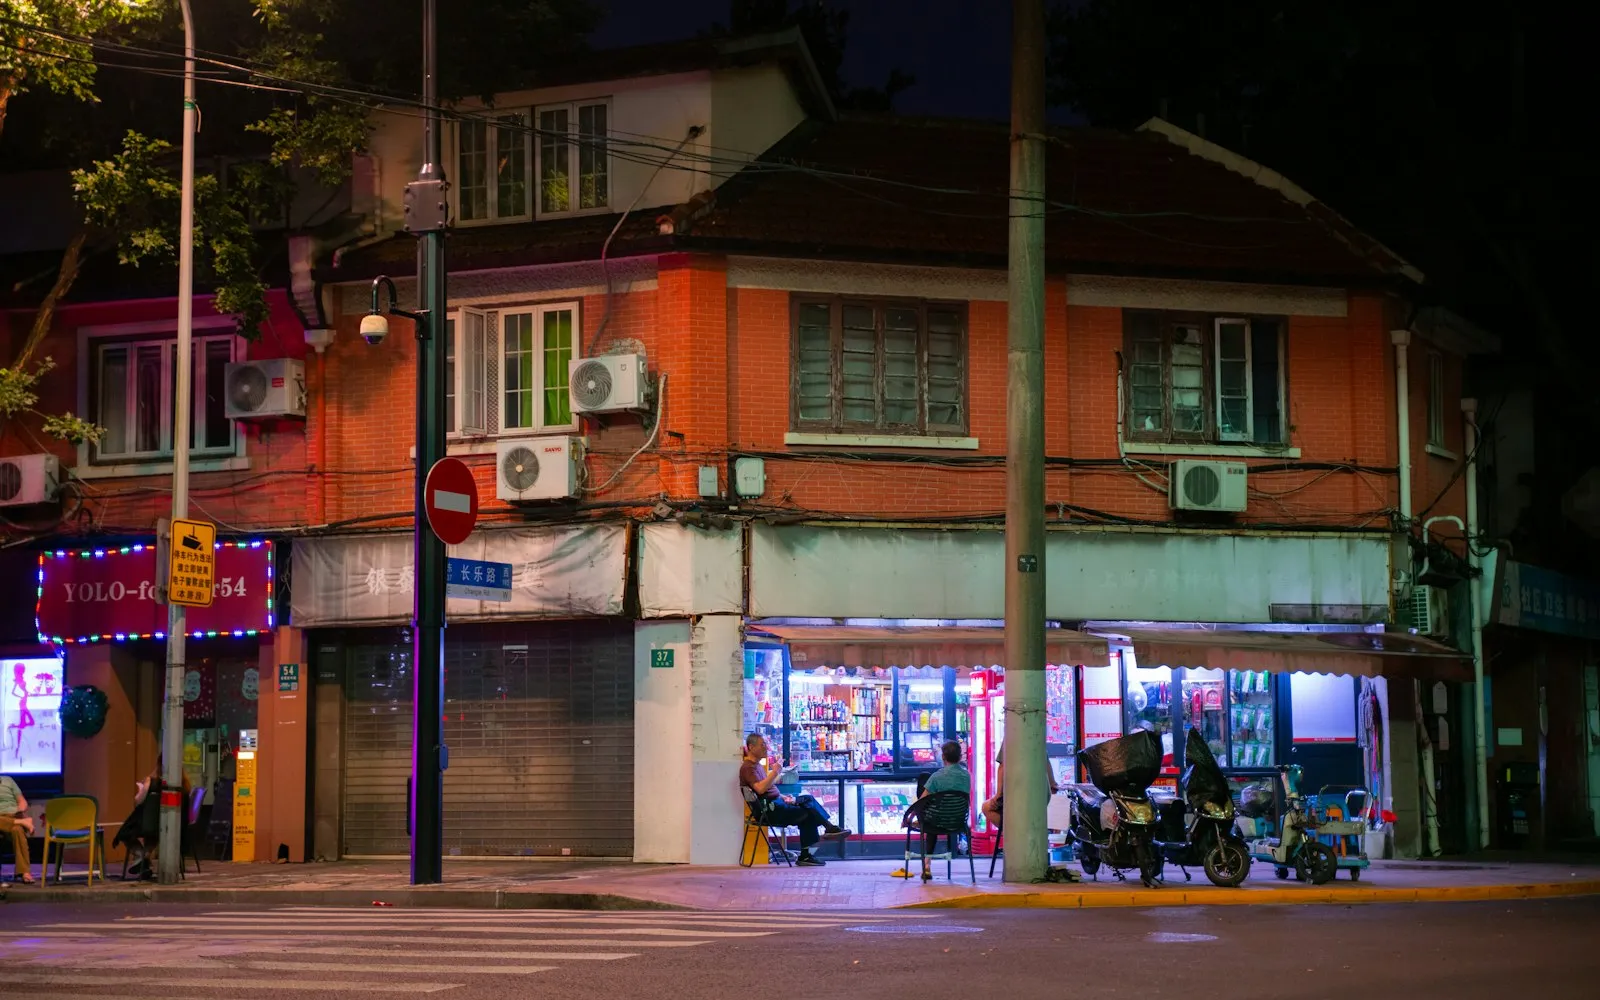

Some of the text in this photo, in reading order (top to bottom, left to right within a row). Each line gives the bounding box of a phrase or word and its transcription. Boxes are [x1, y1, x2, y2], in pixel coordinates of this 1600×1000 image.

[543, 446, 562, 454] SANYO
[173, 549, 212, 563] 停车行为违法
[461, 564, 496, 583] 长乐路
[64, 576, 247, 603] YOLO-for54
[502, 591, 509, 599] W
[656, 651, 668, 662] 37
[283, 665, 294, 676] 54
